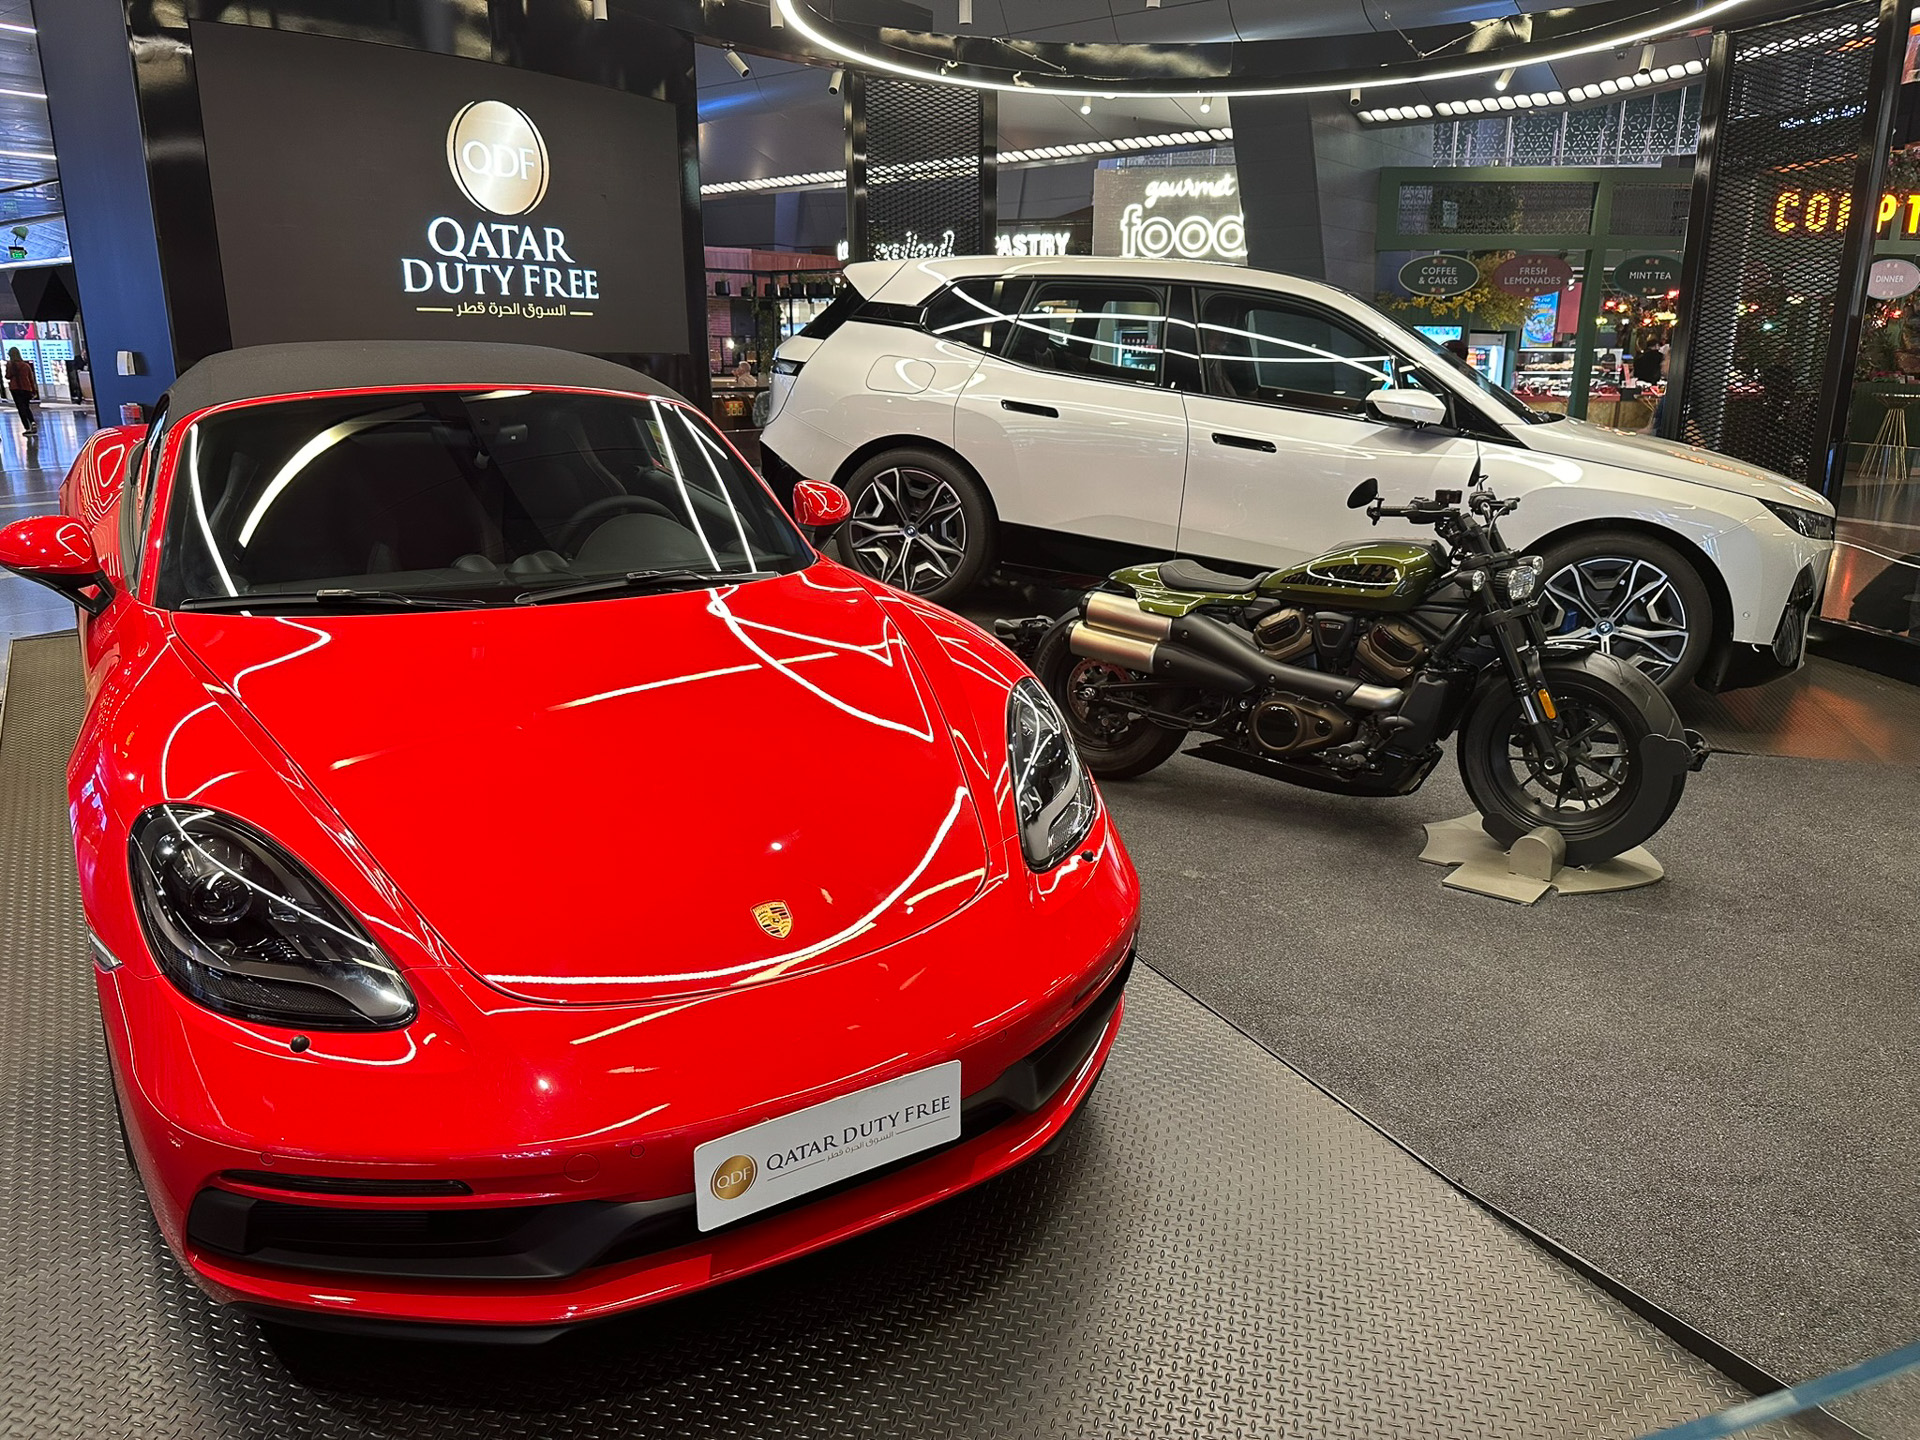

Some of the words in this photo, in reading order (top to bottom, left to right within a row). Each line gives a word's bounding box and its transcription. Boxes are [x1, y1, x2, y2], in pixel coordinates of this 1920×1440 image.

[462, 140, 536, 180] QDF
[1144, 173, 1236, 208] gourmet
[428, 216, 576, 263] QATAR
[1421, 266, 1457, 276] COFFEE
[1519, 266, 1548, 276] FRESH
[1629, 271, 1651, 280] MINT
[1654, 271, 1672, 280] TEA
[401, 258, 515, 296] DUTY
[522, 264, 600, 300] FREE
[1418, 277, 1426, 285] &
[1427, 276, 1458, 286] CAKES
[1504, 276, 1561, 286] LEMONADES
[1875, 275, 1904, 283] DINNER
[456, 301, 486, 317] قطر
[488, 302, 520, 317] الحرة
[522, 304, 567, 319] السوق
[766, 1135, 838, 1171] QATAR
[843, 1112, 900, 1144] DUTY
[904, 1095, 951, 1123] FREE
[716, 1166, 751, 1190] QDF
